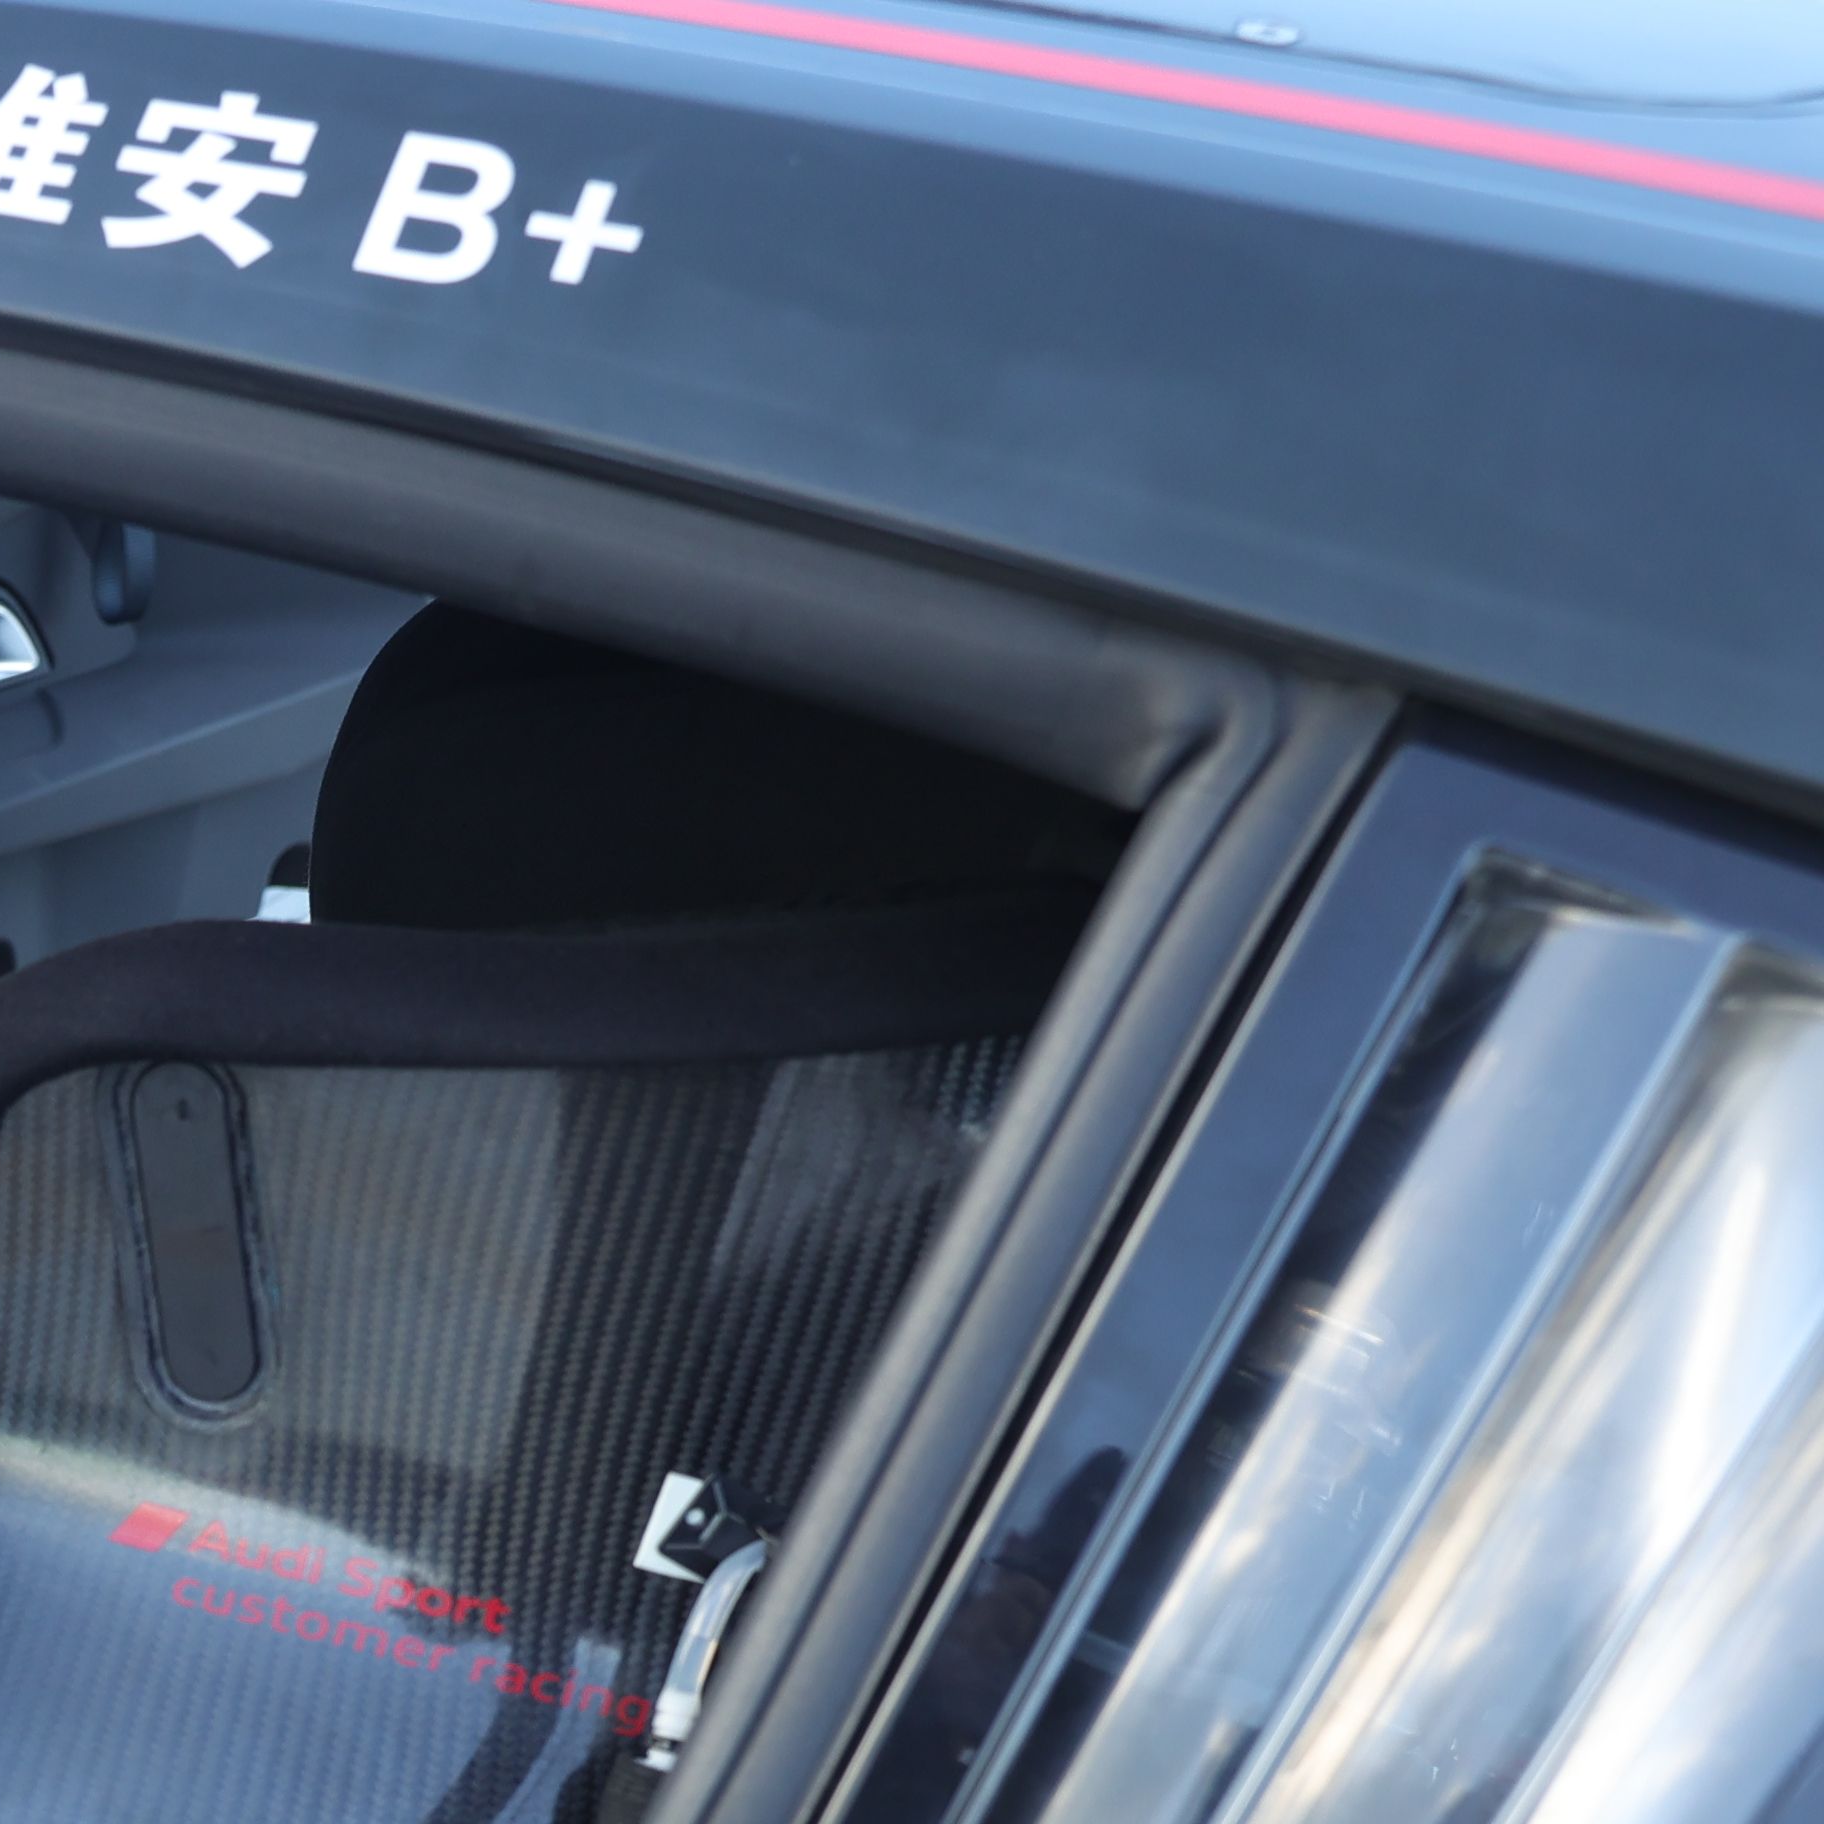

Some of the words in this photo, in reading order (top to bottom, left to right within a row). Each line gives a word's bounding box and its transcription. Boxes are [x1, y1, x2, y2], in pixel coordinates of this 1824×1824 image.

[352, 131, 645, 287] B+
[186, 1518, 324, 1585] Audi
[340, 1557, 511, 1635] Sport
[171, 1574, 457, 1673] customer
[469, 1649, 655, 1736] racing
